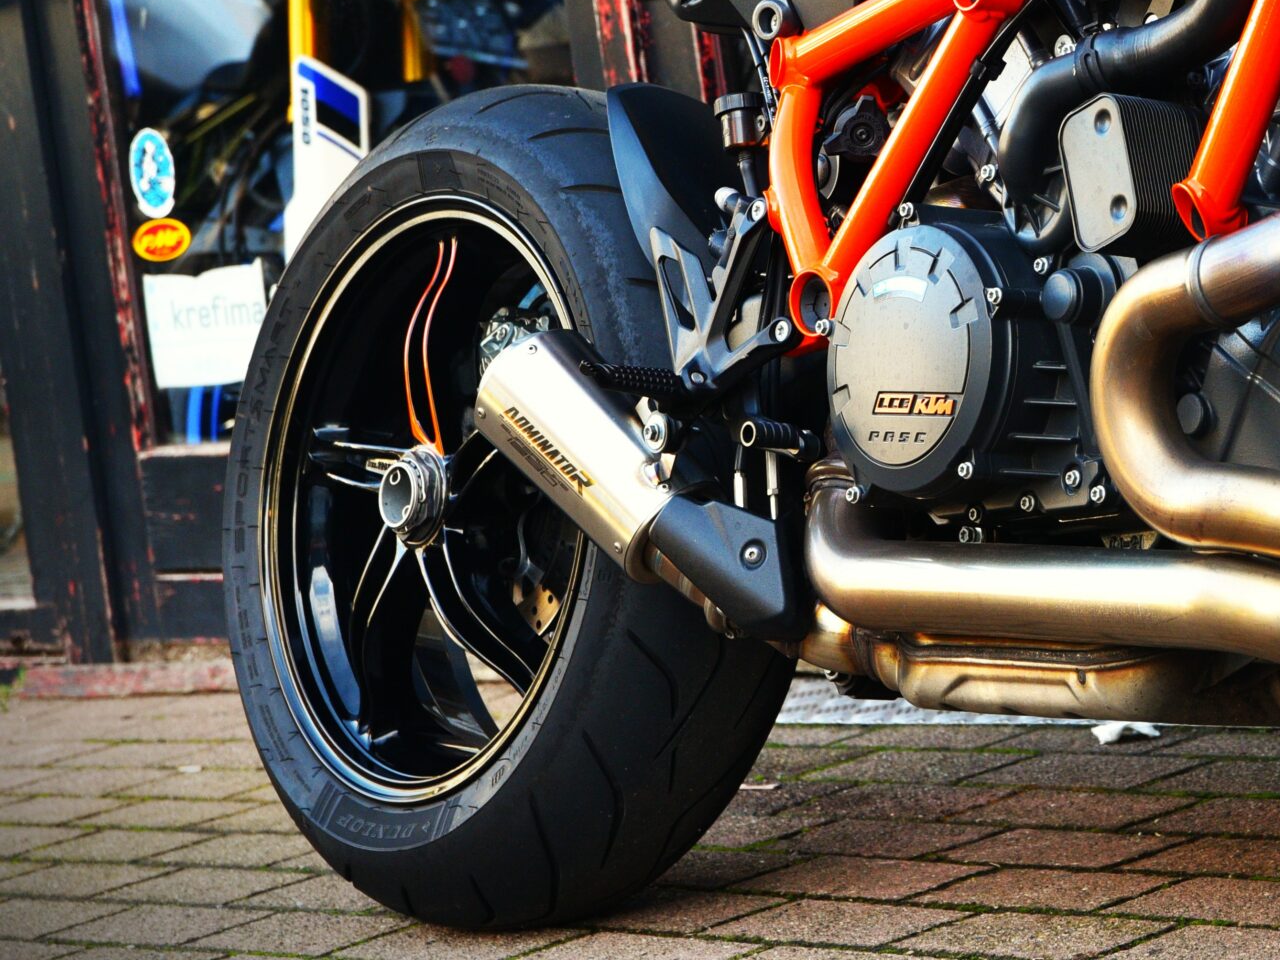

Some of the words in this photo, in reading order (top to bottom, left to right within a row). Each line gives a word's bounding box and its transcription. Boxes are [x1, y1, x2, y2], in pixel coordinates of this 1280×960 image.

[913, 394, 954, 415] KTM
[504, 406, 595, 496] DOMINATOR
[336, 813, 417, 839] DUNLOP
